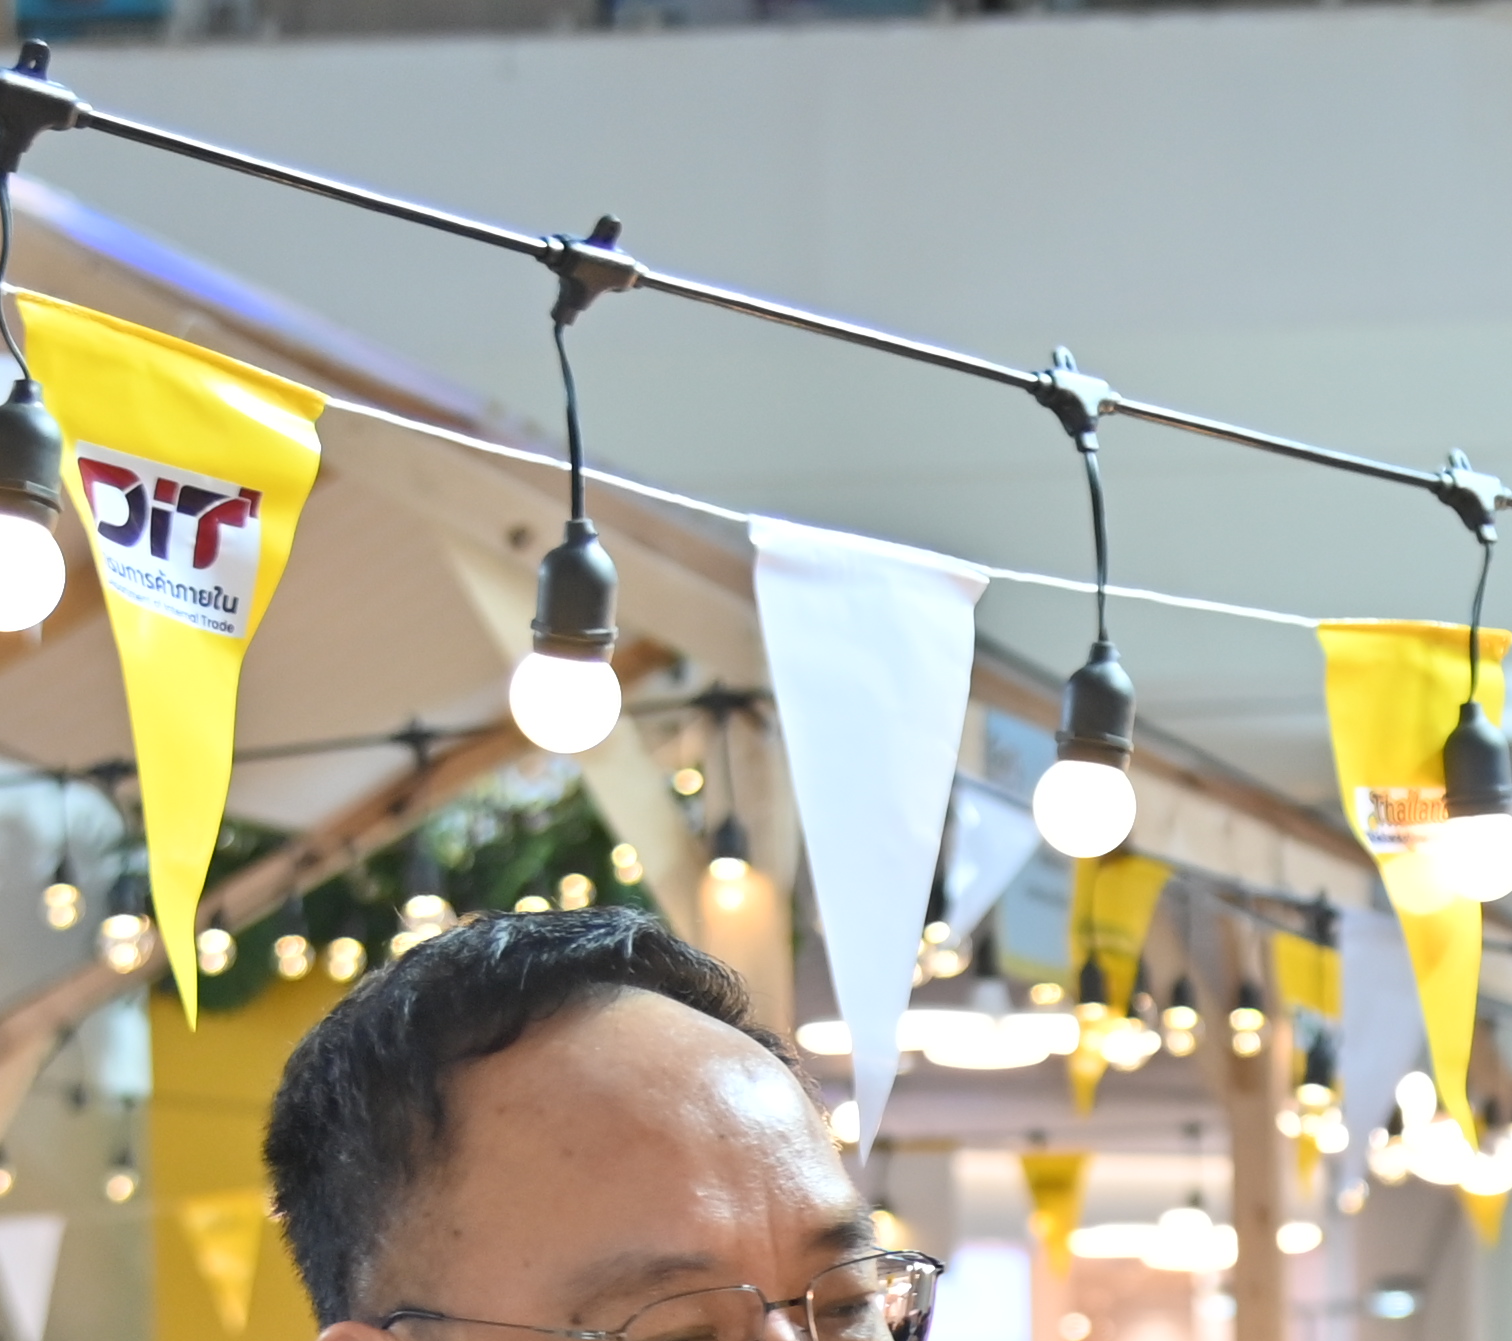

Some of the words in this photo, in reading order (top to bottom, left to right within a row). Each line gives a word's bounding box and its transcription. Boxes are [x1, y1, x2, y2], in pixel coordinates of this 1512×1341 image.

[103, 555, 239, 615] รมการค้าภายใน
[201, 614, 235, 634] Trade
